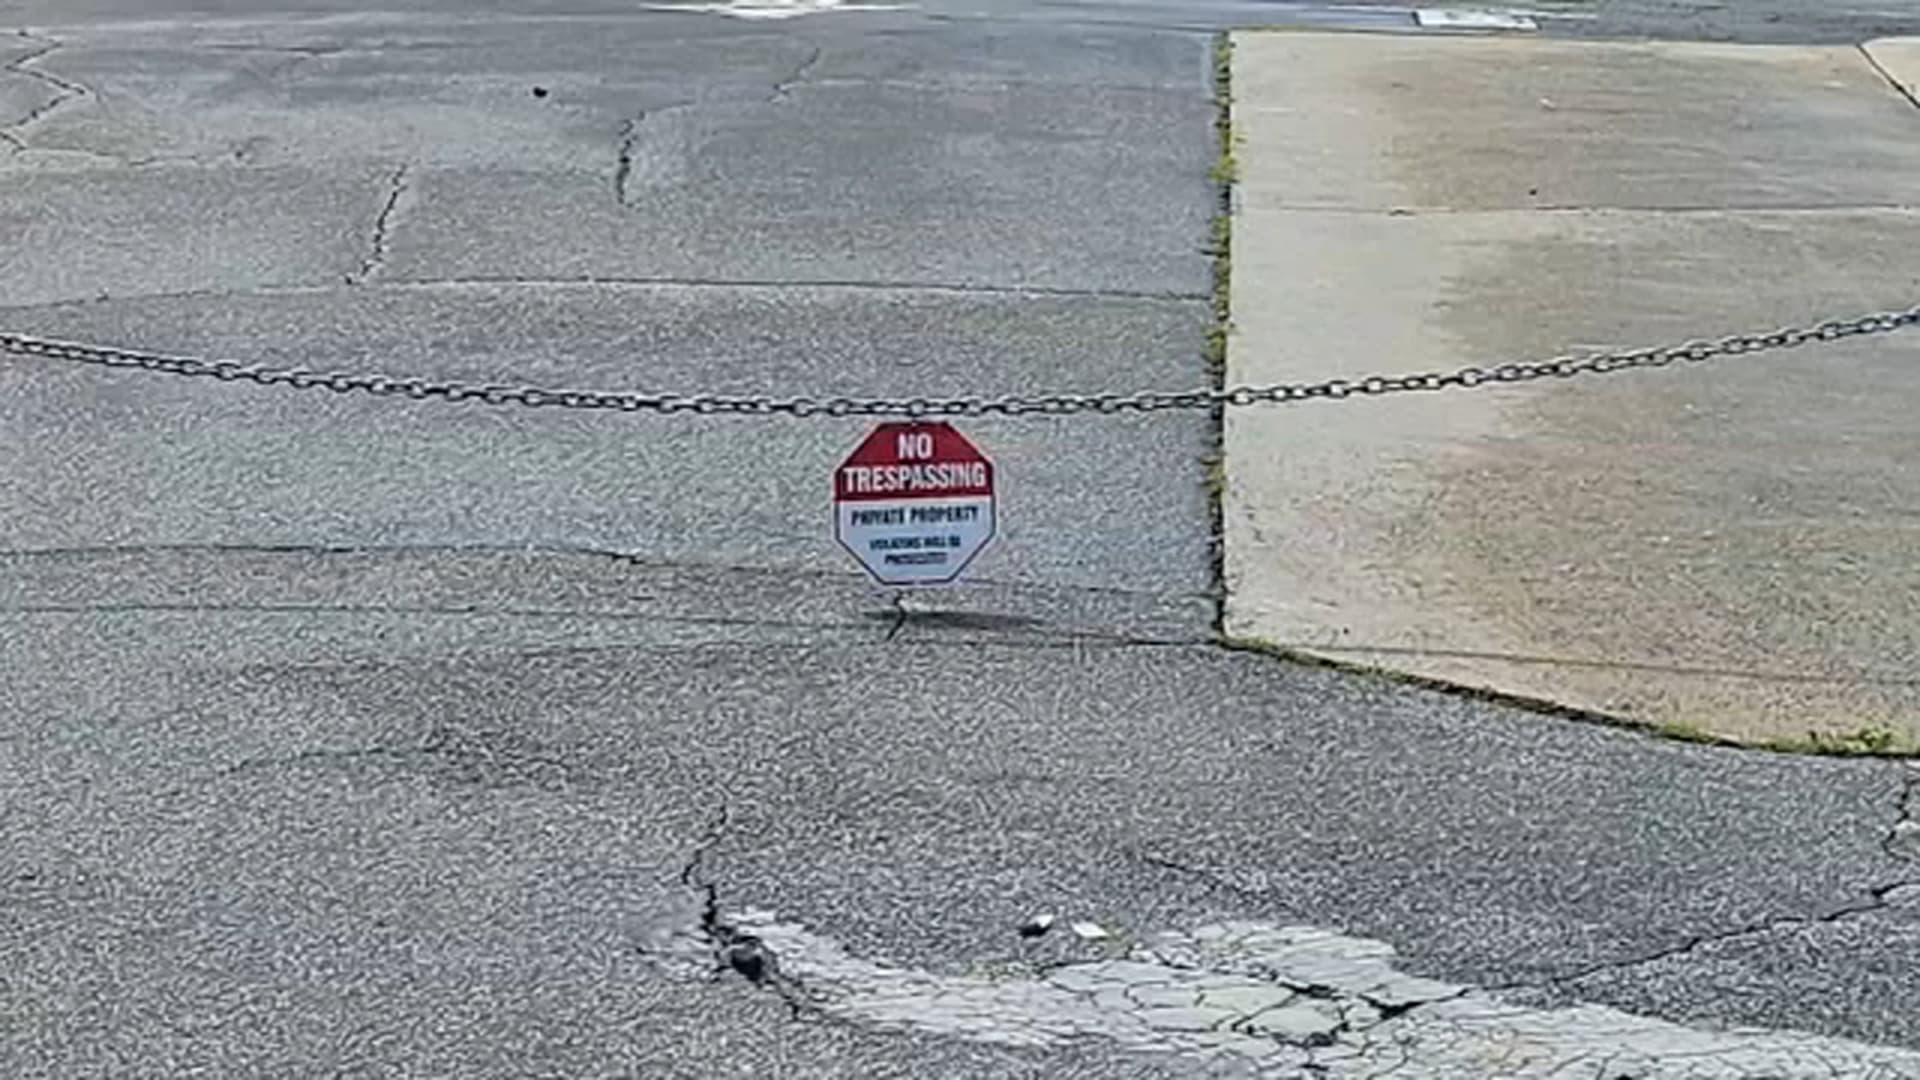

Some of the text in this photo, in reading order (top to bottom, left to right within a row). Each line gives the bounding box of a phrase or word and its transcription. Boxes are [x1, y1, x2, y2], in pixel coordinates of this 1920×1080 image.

[898, 433, 933, 459] NO
[843, 462, 987, 492] TRESPASSING
[851, 505, 978, 526] PRIVATE PROPERTY
